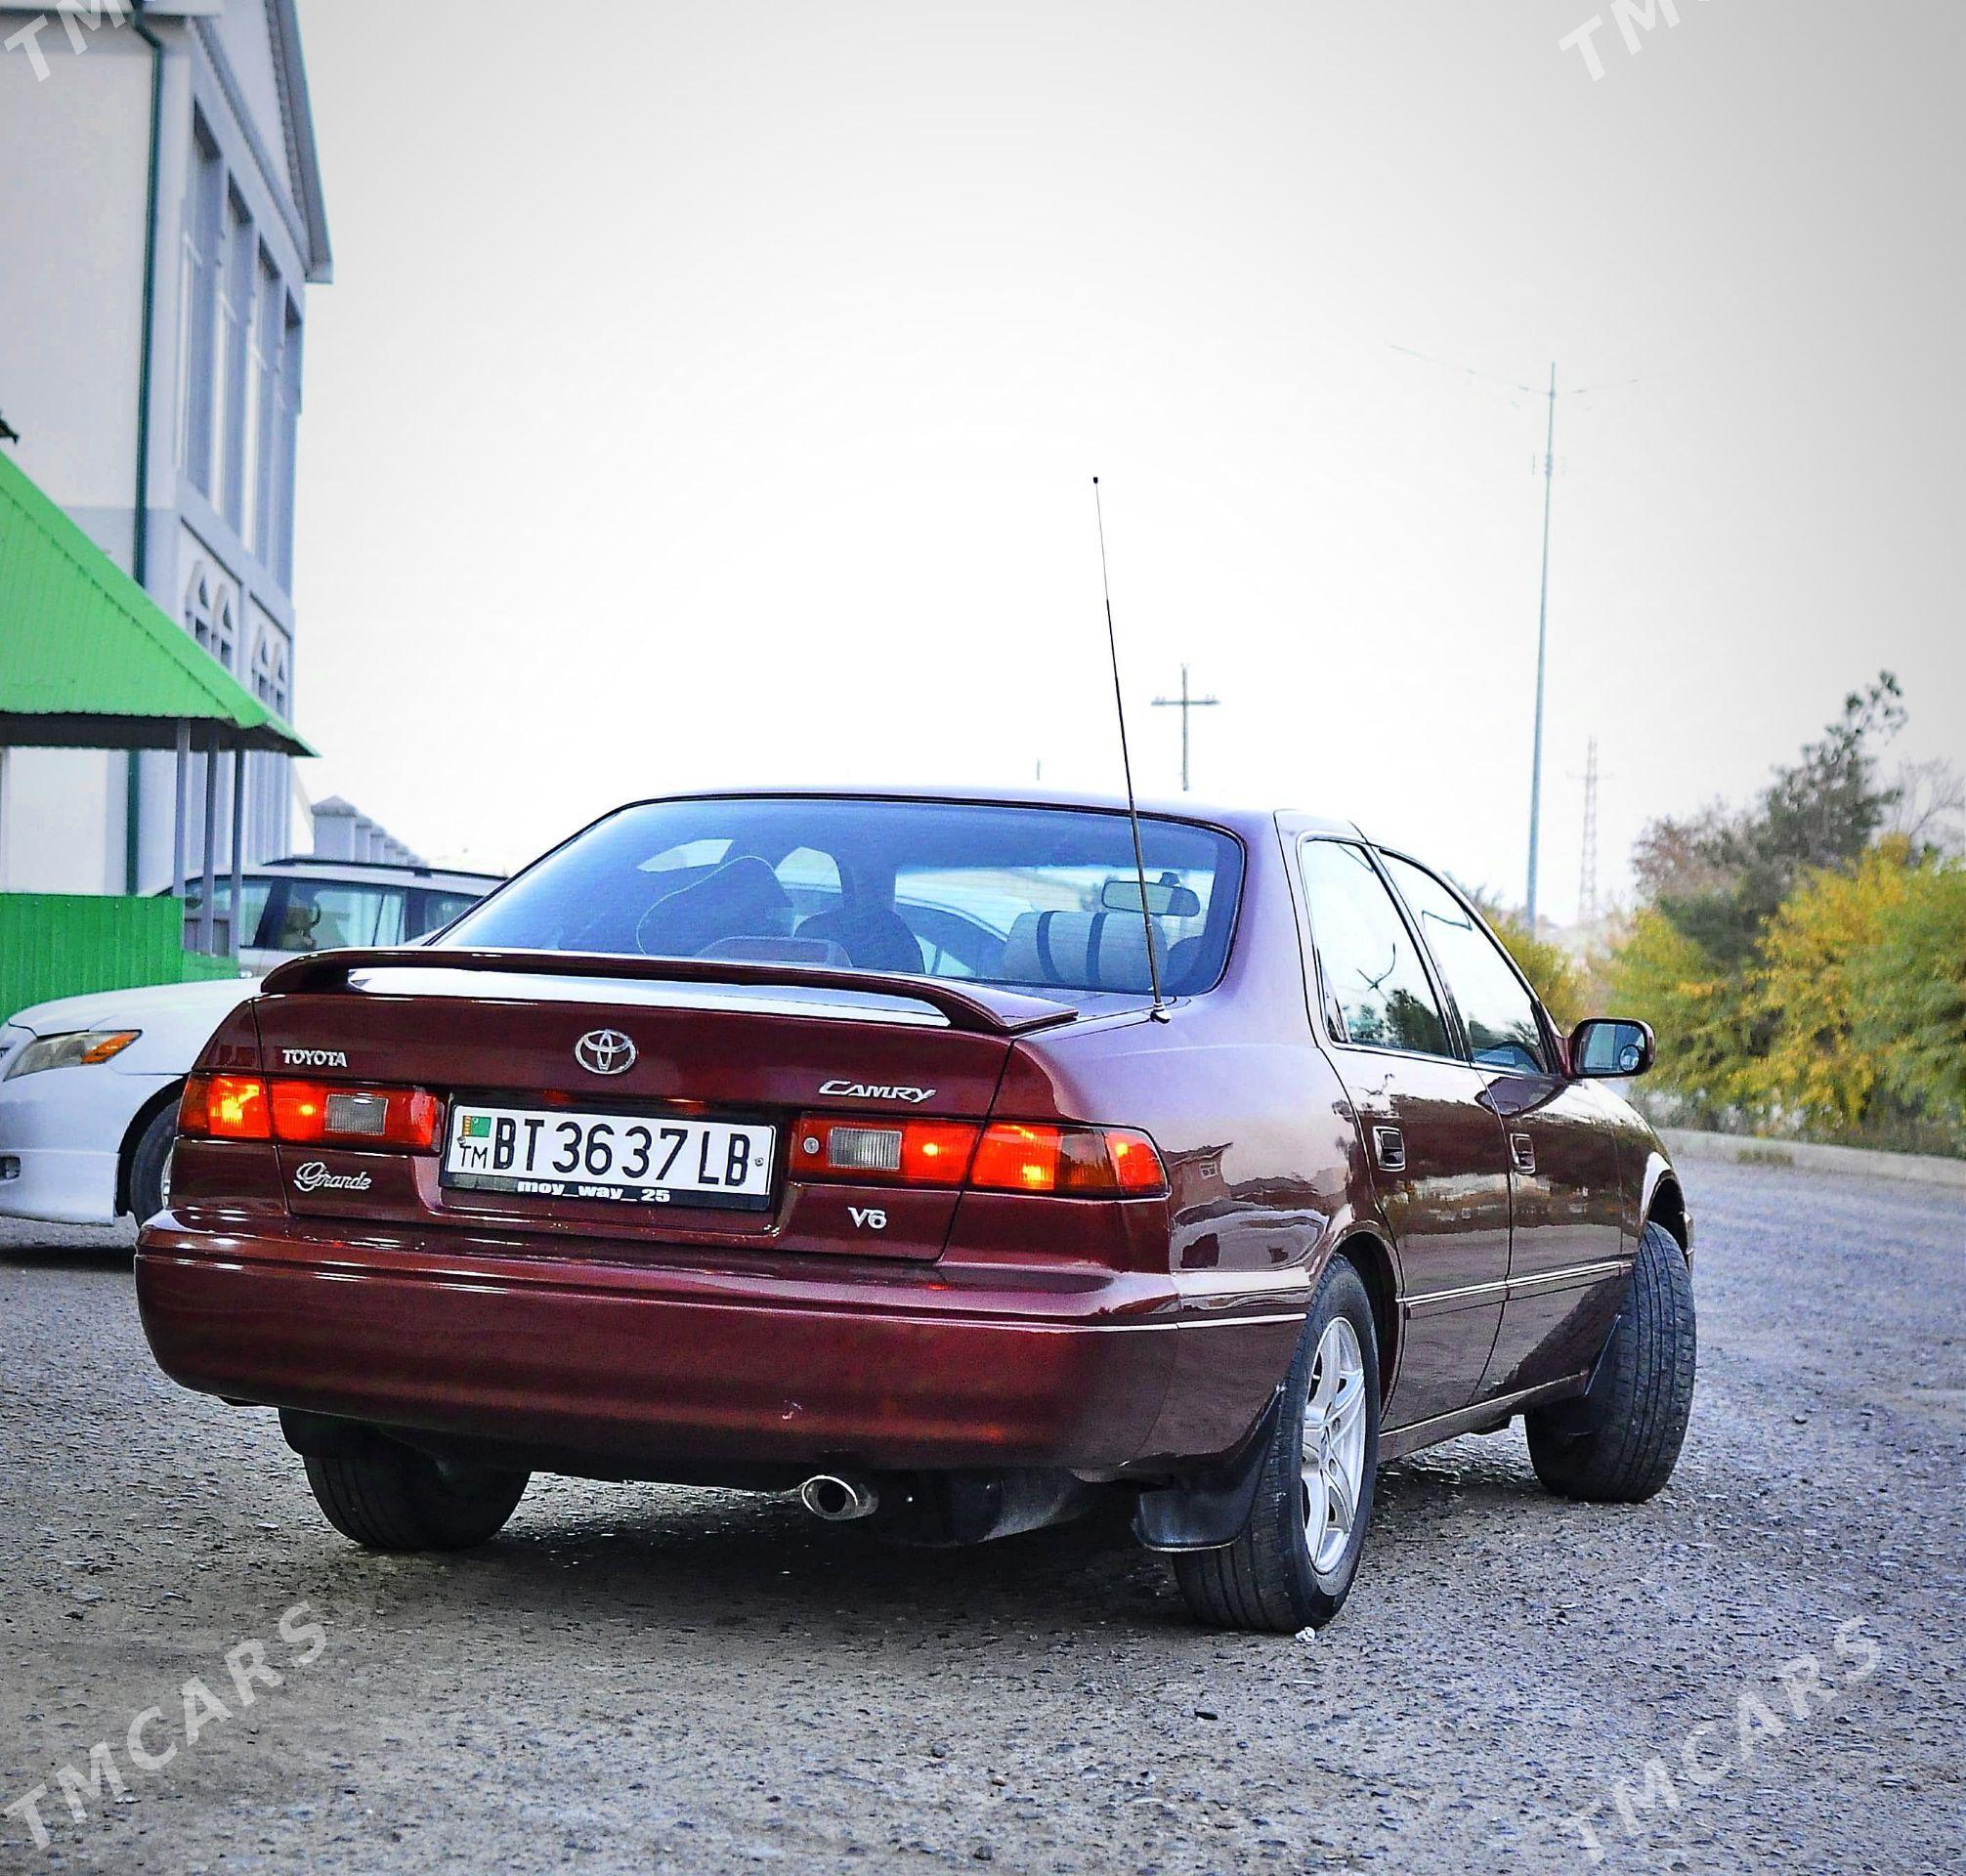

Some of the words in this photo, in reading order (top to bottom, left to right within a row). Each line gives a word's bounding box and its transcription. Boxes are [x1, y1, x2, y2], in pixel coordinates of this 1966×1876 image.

[282, 1049, 348, 1067] TOYOTA
[819, 1080, 936, 1103] CAMRY
[460, 1145, 488, 1169] TM
[293, 1161, 372, 1192] Grande
[847, 1207, 887, 1229] V6
